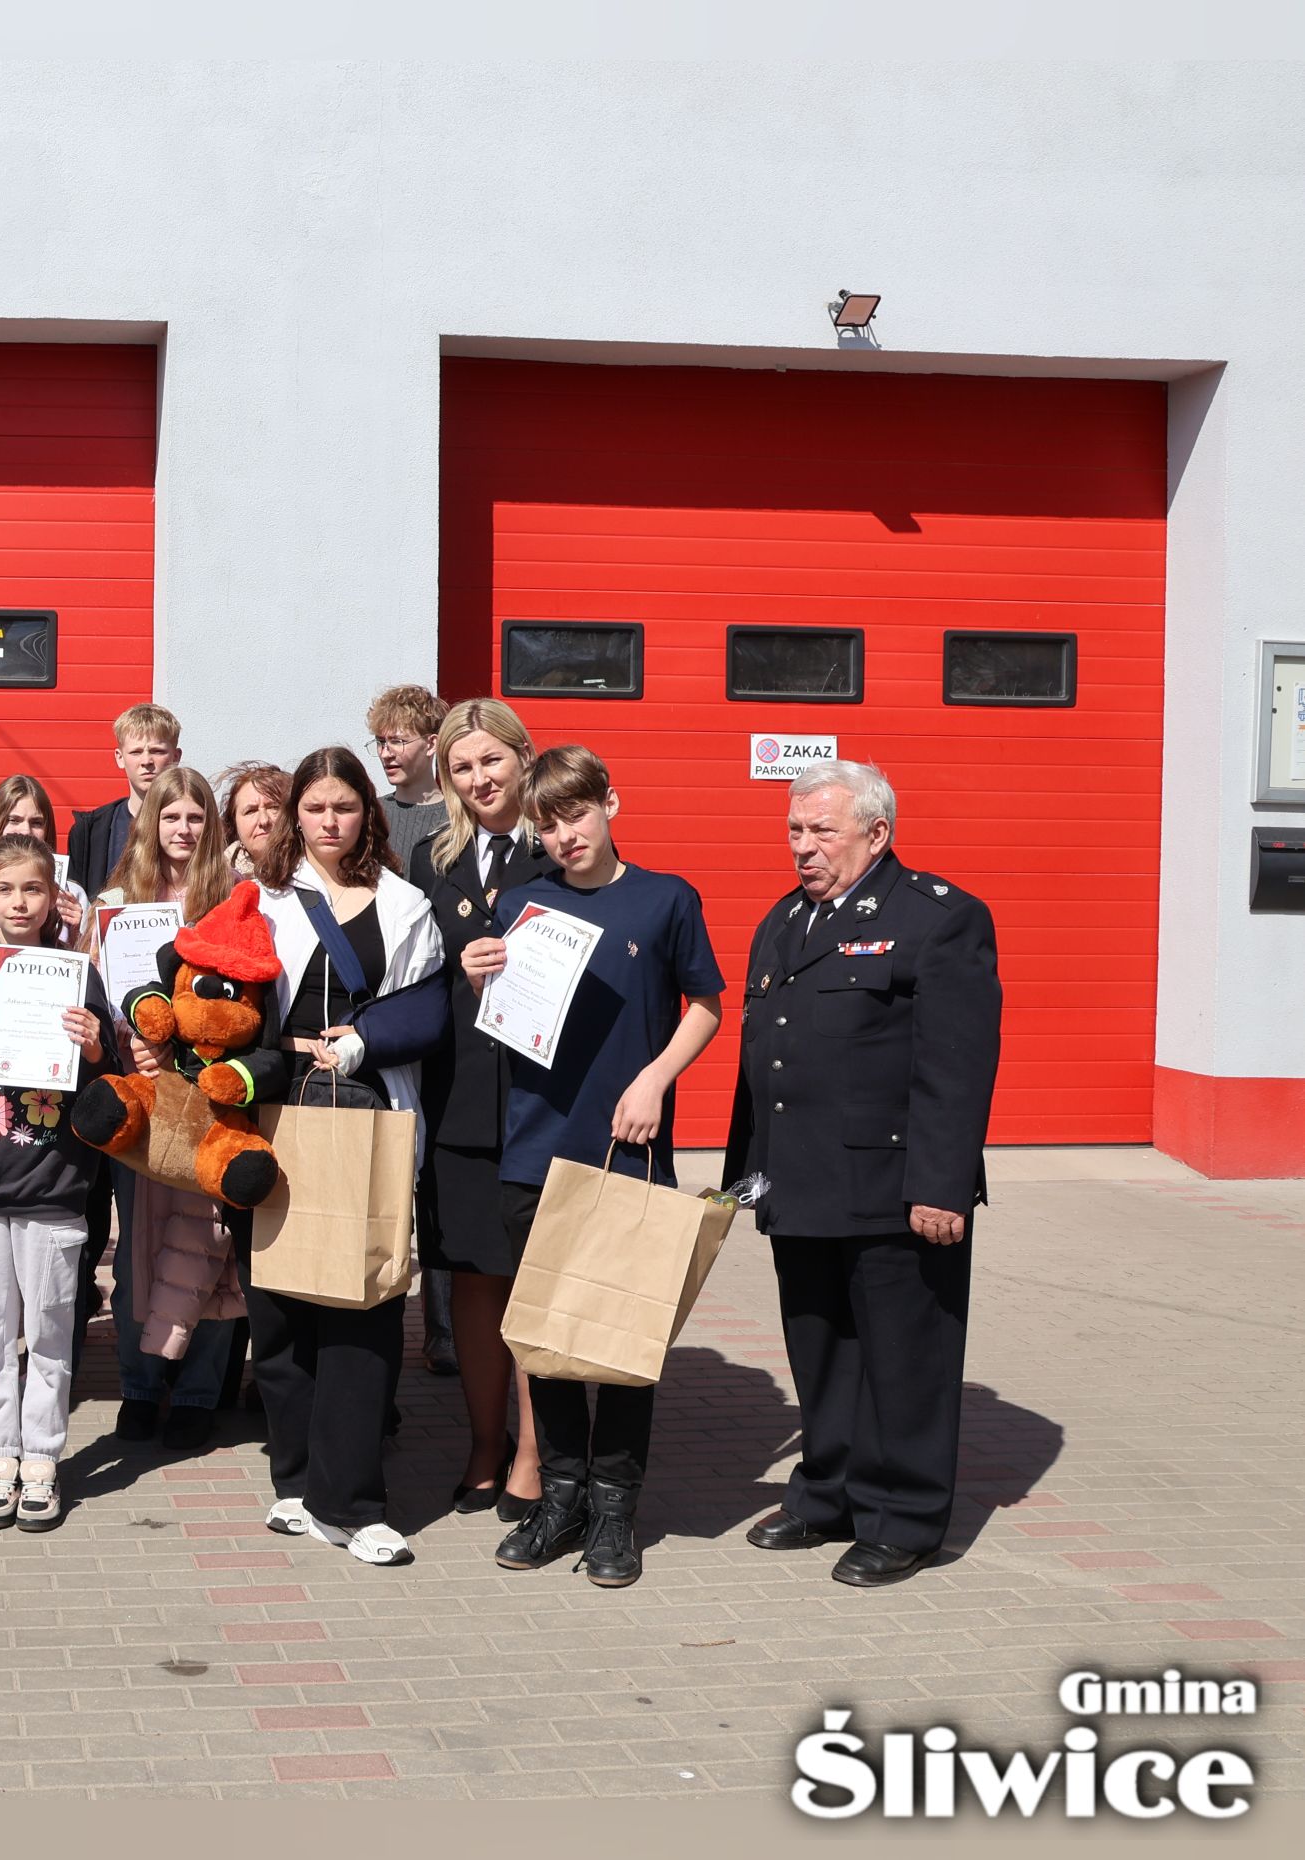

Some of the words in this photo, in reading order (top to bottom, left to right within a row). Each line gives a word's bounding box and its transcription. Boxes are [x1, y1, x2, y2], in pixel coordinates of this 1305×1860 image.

[783, 745, 832, 758] ZAKAZ
[755, 766, 806, 775] PARKOW
[113, 917, 170, 931] DYPLOM
[524, 920, 579, 950] DYPLOM
[6, 962, 70, 978] DYPLOM
